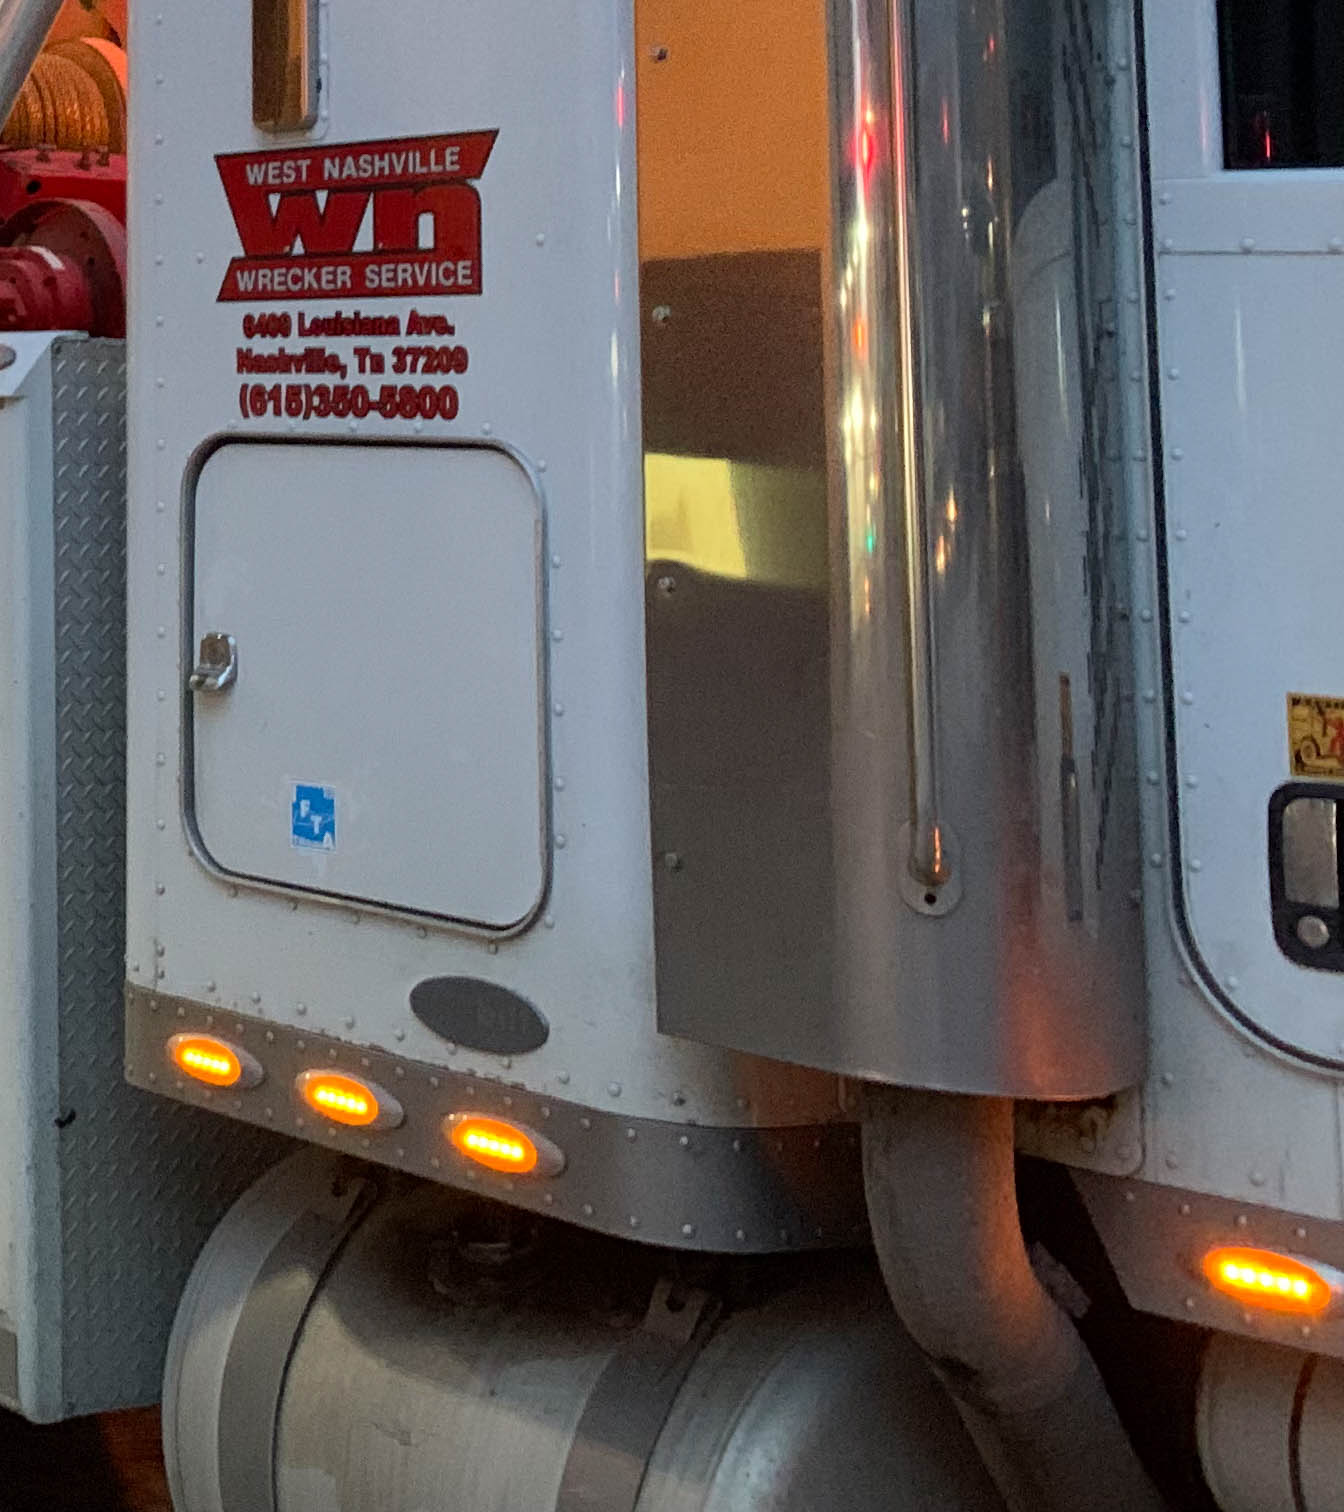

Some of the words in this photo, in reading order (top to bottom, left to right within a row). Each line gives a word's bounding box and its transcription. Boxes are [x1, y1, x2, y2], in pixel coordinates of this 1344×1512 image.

[245, 159, 311, 186] WEST
[323, 146, 461, 181] NASHVILLE
[236, 266, 352, 292] WRECKER
[365, 260, 473, 288] SERVICE
[297, 310, 401, 337] Louisiana
[406, 308, 455, 336] Ave.
[236, 346, 347, 380] Nashville,
[353, 346, 385, 374] Tn
[391, 346, 469, 375] 37209
[239, 383, 459, 420] (615)350-5800
